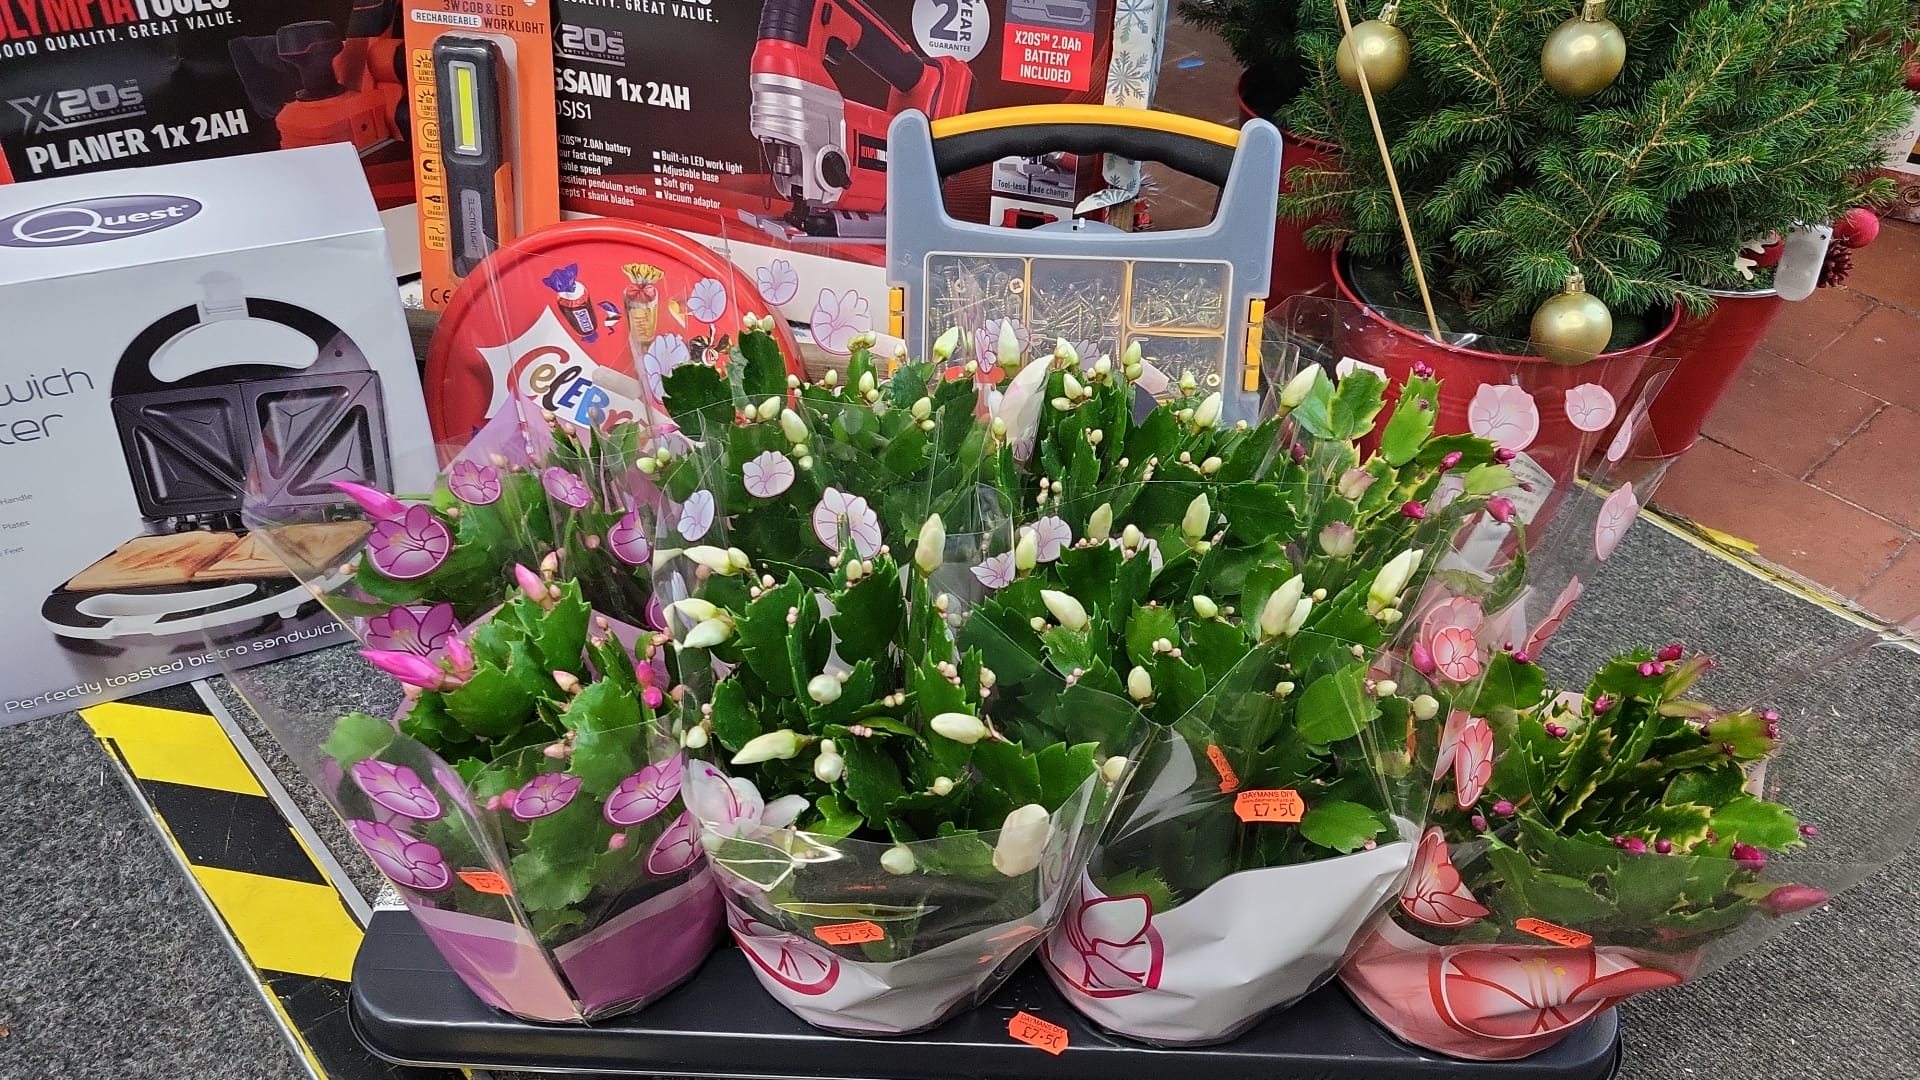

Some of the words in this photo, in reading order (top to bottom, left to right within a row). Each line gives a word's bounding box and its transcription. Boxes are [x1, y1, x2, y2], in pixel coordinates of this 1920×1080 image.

[443, 0, 460, 11] 3W
[462, 0, 484, 13] COB
[486, 5, 494, 15] &
[495, 4, 514, 17] LED
[625, 0, 666, 15] GREAT
[672, 4, 719, 23] VALUE.
[416, 11, 478, 26] RECHARGEABLE
[484, 17, 545, 34] WORKLIGHT
[929, 0, 958, 41] 2
[959, 0, 973, 42] YEAR
[0, 41, 37, 58] OOD
[45, 29, 124, 51] QUALITY.
[129, 19, 179, 39] GREAT
[186, 11, 242, 30] VALUE.
[1051, 34, 1082, 52] 2.0Ah
[929, 40, 972, 53] GUARANTEE
[1024, 48, 1070, 67] BATTERY
[1020, 64, 1071, 83] INCLUDED
[616, 77, 644, 104] 1x
[646, 82, 690, 111] 2AH
[26, 128, 150, 174] PLANER
[151, 124, 190, 149] 1x
[190, 109, 249, 143] 2AH
[583, 138, 604, 150] 2.0Ah
[605, 141, 631, 157] battery
[572, 149, 587, 161] fast
[588, 152, 613, 166] charge
[661, 150, 689, 164] Built-in
[690, 155, 704, 167] LED
[706, 159, 724, 171] work
[725, 161, 743, 175] light
[580, 165, 602, 176] speed
[662, 164, 701, 180] Adjustable
[702, 171, 719, 183] base
[588, 179, 624, 192] pendulum
[625, 185, 647, 196] action
[663, 177, 678, 188] Soft
[680, 181, 694, 193] grip
[997, 179, 1026, 191] Tool-less
[1046, 188, 1069, 198] change
[582, 189, 586, 199] T
[588, 191, 610, 203] shank
[611, 194, 635, 206] blades
[663, 190, 692, 204] Vacuum
[693, 197, 720, 210] adaptor
[4, 680, 103, 713] Perfectly
[104, 659, 184, 688] toasted
[188, 643, 248, 668] bistro
[253, 620, 343, 652] sandwich
[1242, 791, 1279, 800] DAYMANS
[1281, 790, 1294, 798] DIY
